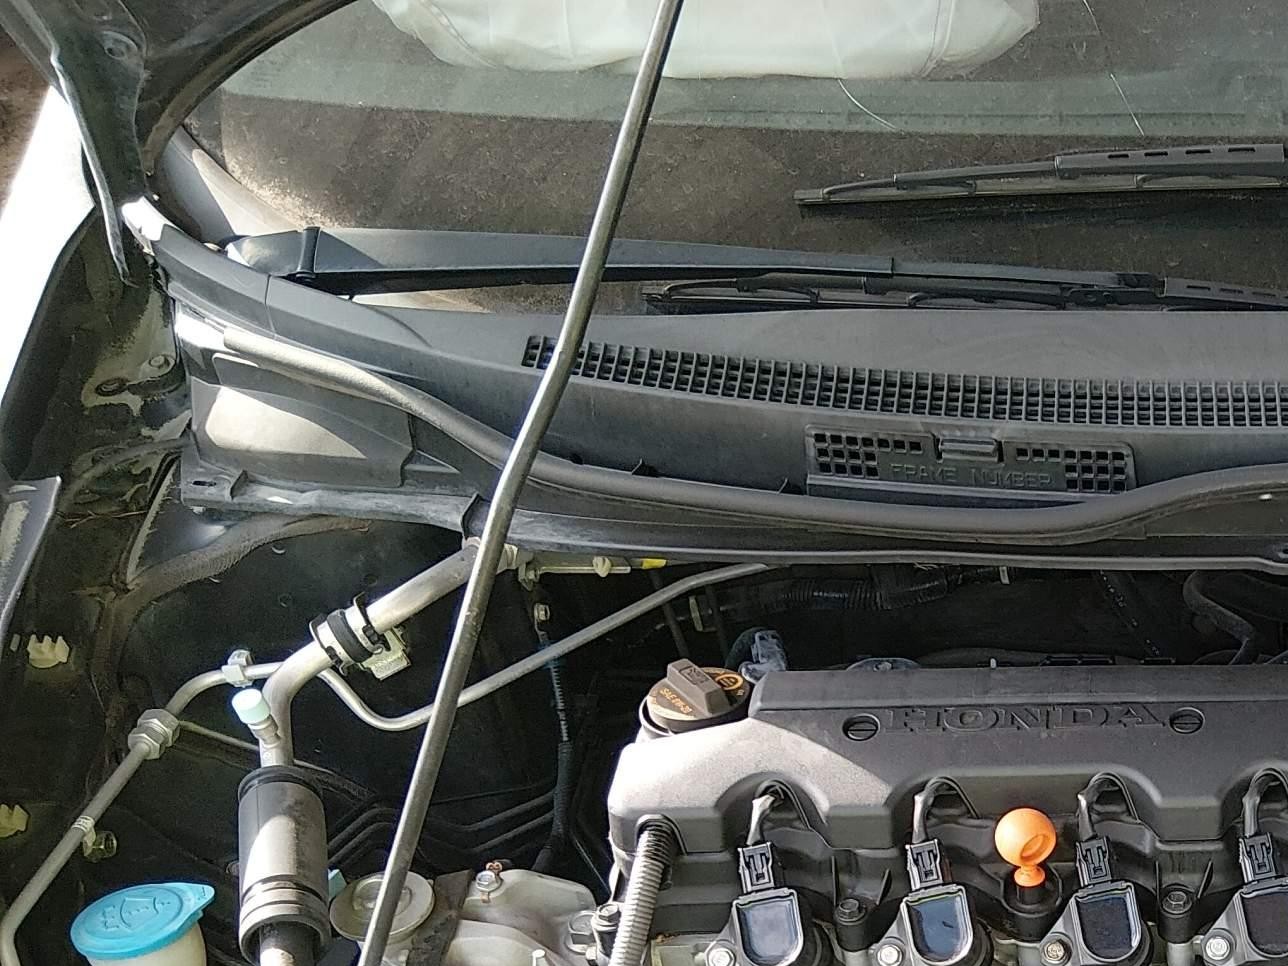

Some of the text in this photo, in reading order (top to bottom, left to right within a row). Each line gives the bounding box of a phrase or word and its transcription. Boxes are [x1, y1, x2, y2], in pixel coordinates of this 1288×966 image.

[889, 463, 1053, 488] FRAME NUMBER
[875, 697, 1167, 732] HONDA
